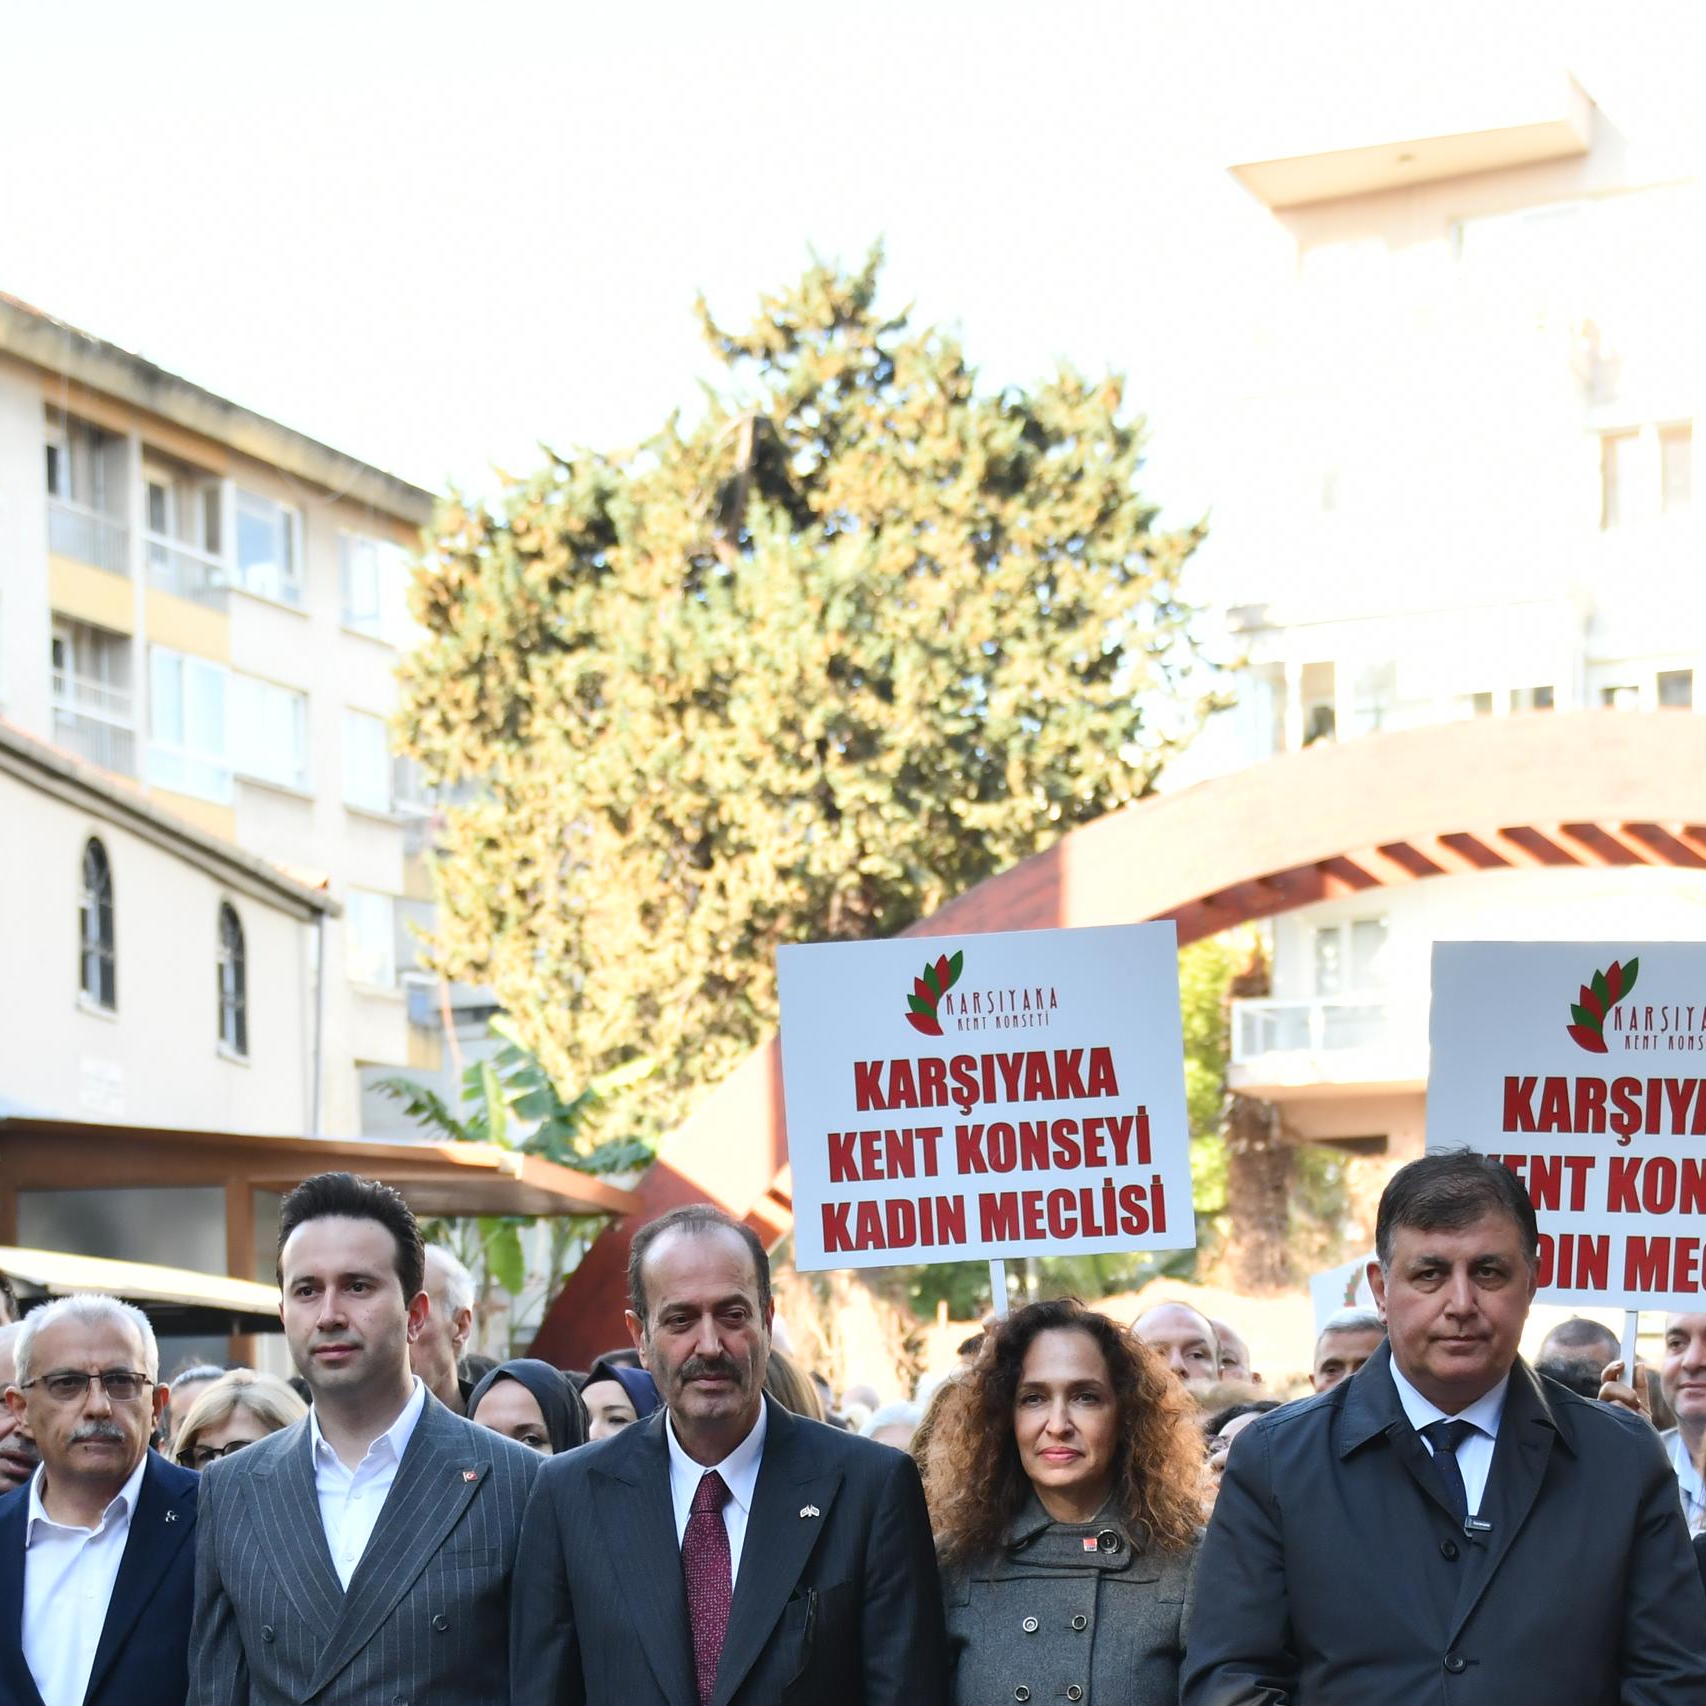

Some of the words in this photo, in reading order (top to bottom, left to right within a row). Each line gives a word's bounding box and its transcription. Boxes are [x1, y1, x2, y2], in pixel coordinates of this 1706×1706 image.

[946, 987, 1058, 1015] KARŞIYAKA
[957, 1016, 986, 1031] KENT
[996, 1010, 1049, 1029] KONSEYİ
[1624, 1035, 1658, 1050] KENT
[854, 1046, 1119, 1116] KARŞIYAKA
[827, 1126, 943, 1183] KENT
[955, 1105, 1152, 1177] KONSEYİ
[821, 1194, 967, 1253] KADIN
[978, 1174, 1167, 1246] MECLİSİ
